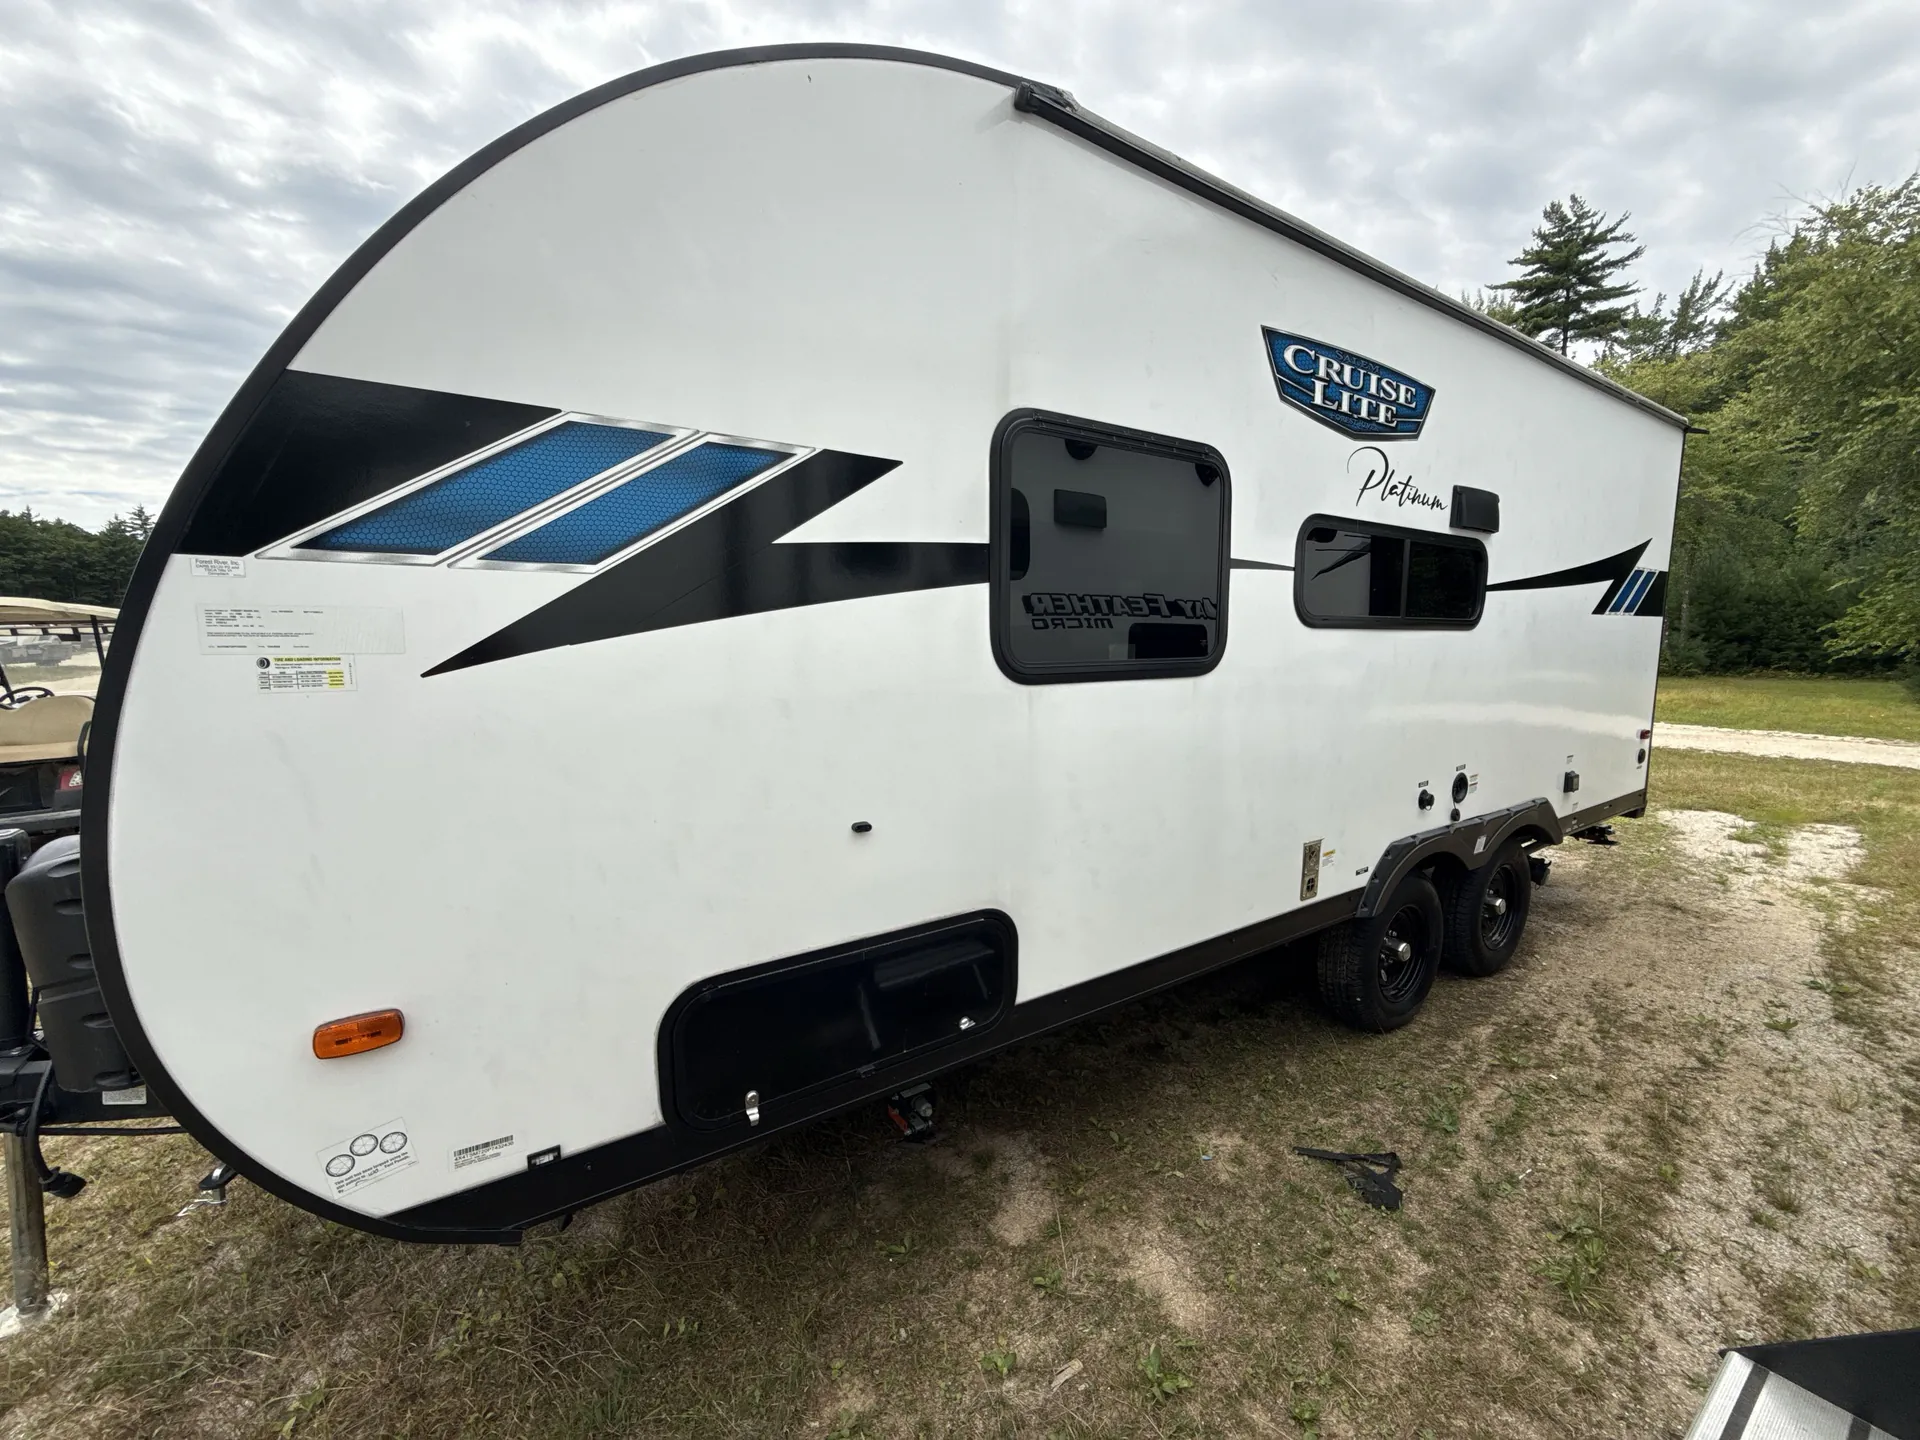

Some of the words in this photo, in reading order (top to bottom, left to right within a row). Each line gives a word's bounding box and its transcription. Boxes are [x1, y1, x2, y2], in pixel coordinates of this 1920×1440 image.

[1283, 344, 1416, 408] CRUISE
[1335, 350, 1380, 374] SALEM
[1311, 378, 1397, 428] LITE
[1347, 446, 1448, 511] Platinum
